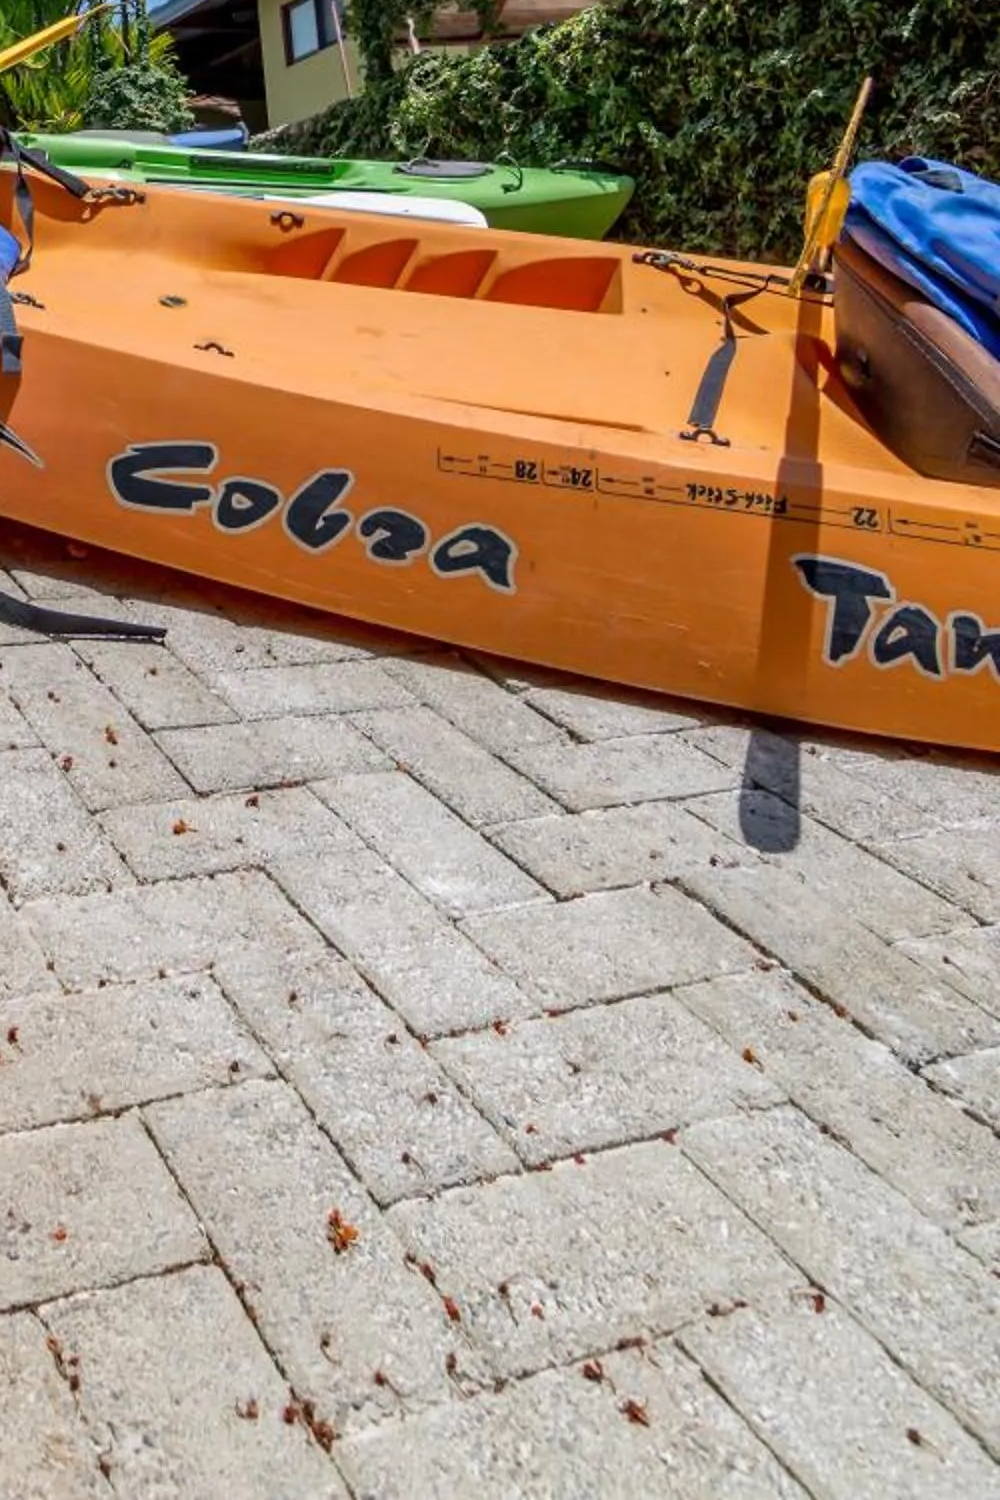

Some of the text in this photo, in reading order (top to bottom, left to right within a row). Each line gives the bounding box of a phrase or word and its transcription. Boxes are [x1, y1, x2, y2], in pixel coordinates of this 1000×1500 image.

[515, 459, 538, 481] 28
[570, 467, 593, 487] 24
[107, 442, 517, 594] Cobra
[852, 506, 878, 529] 22
